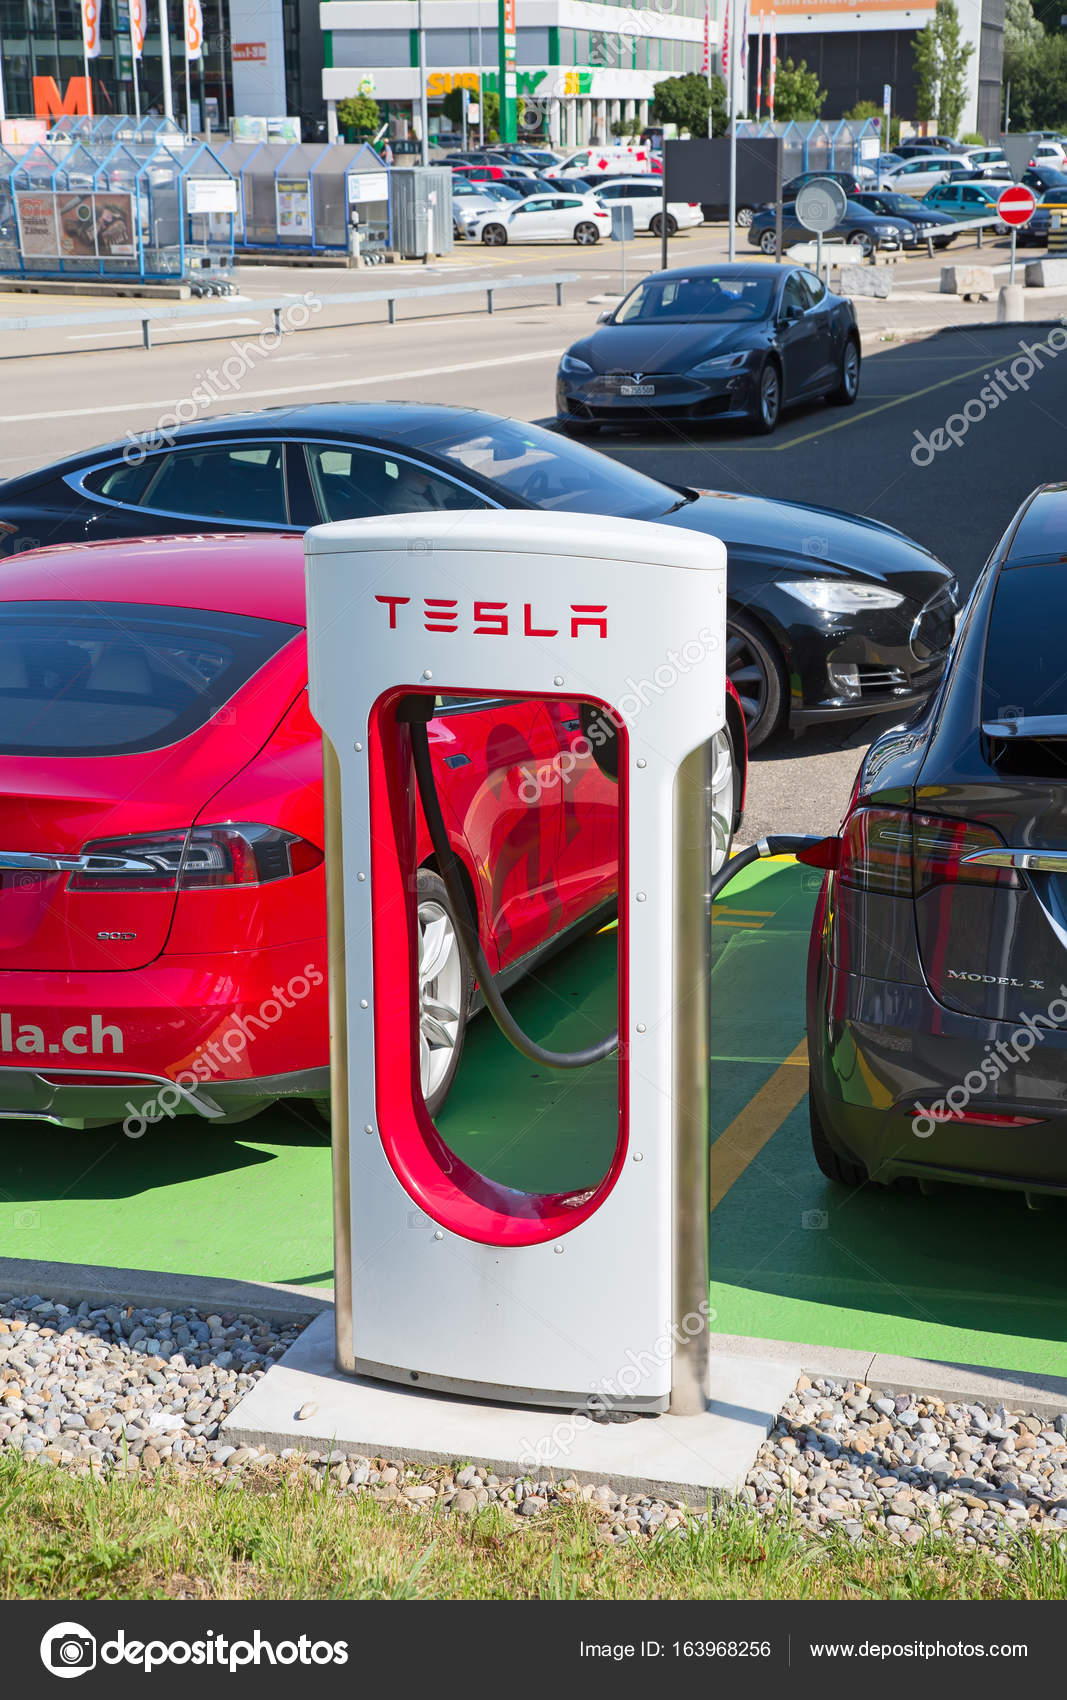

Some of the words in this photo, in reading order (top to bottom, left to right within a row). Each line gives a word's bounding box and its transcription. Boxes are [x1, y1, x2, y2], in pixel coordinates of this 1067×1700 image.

[33, 76, 94, 130] M
[374, 595, 608, 639] TESLA
[947, 969, 1024, 987] MODEL
[1029, 979, 1045, 990] X
[0, 1013, 124, 1054] la.ch
